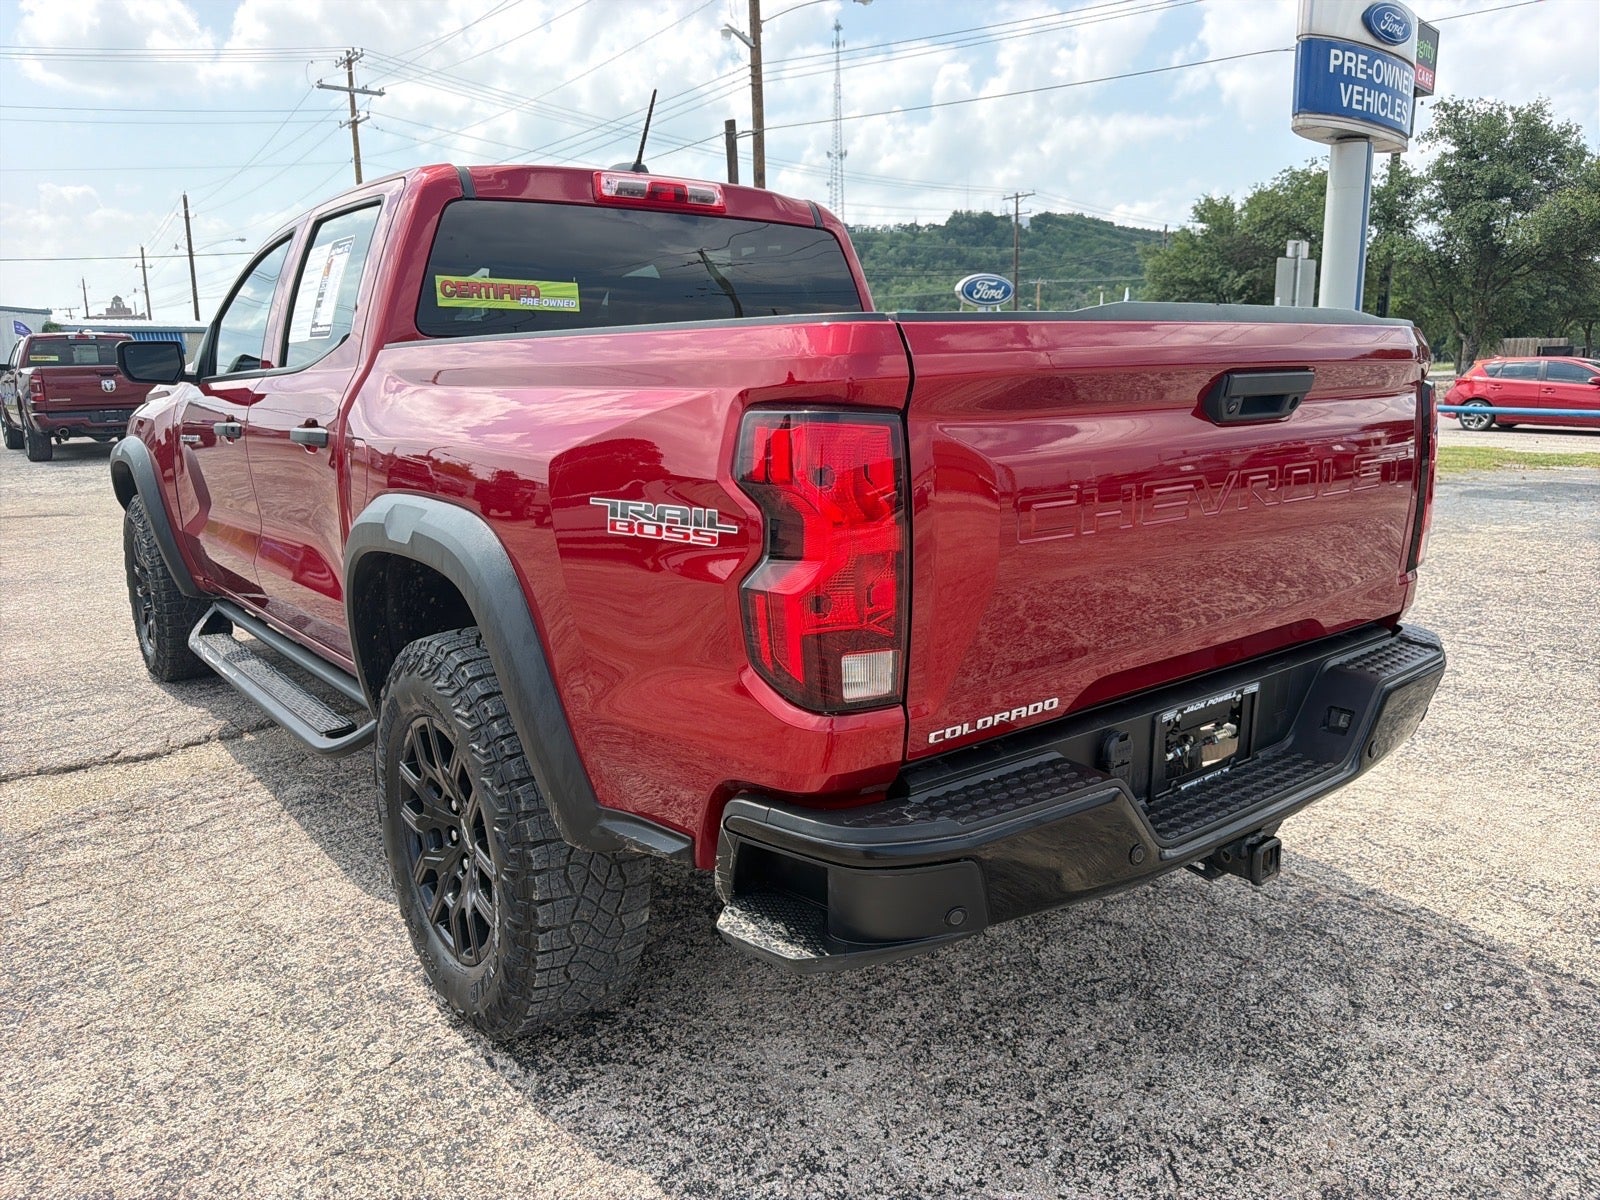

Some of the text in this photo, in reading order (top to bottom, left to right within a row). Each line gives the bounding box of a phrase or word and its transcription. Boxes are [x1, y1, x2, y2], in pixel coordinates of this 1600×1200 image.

[1380, 11, 1405, 36] Ford
[1329, 48, 1413, 98] PRE-OWNED
[1417, 68, 1433, 88] CARE
[1340, 82, 1408, 126] VEHICLES
[440, 279, 540, 301] CERTIFIED
[520, 297, 576, 308] PRE-OWNED
[972, 280, 1005, 300] Ford
[1016, 446, 1408, 544] CHEVROLET
[589, 497, 738, 534] TRAIL
[607, 518, 719, 547] BOSS
[1183, 691, 1237, 714] JACK POWELL
[928, 697, 1059, 744] COLORADO
